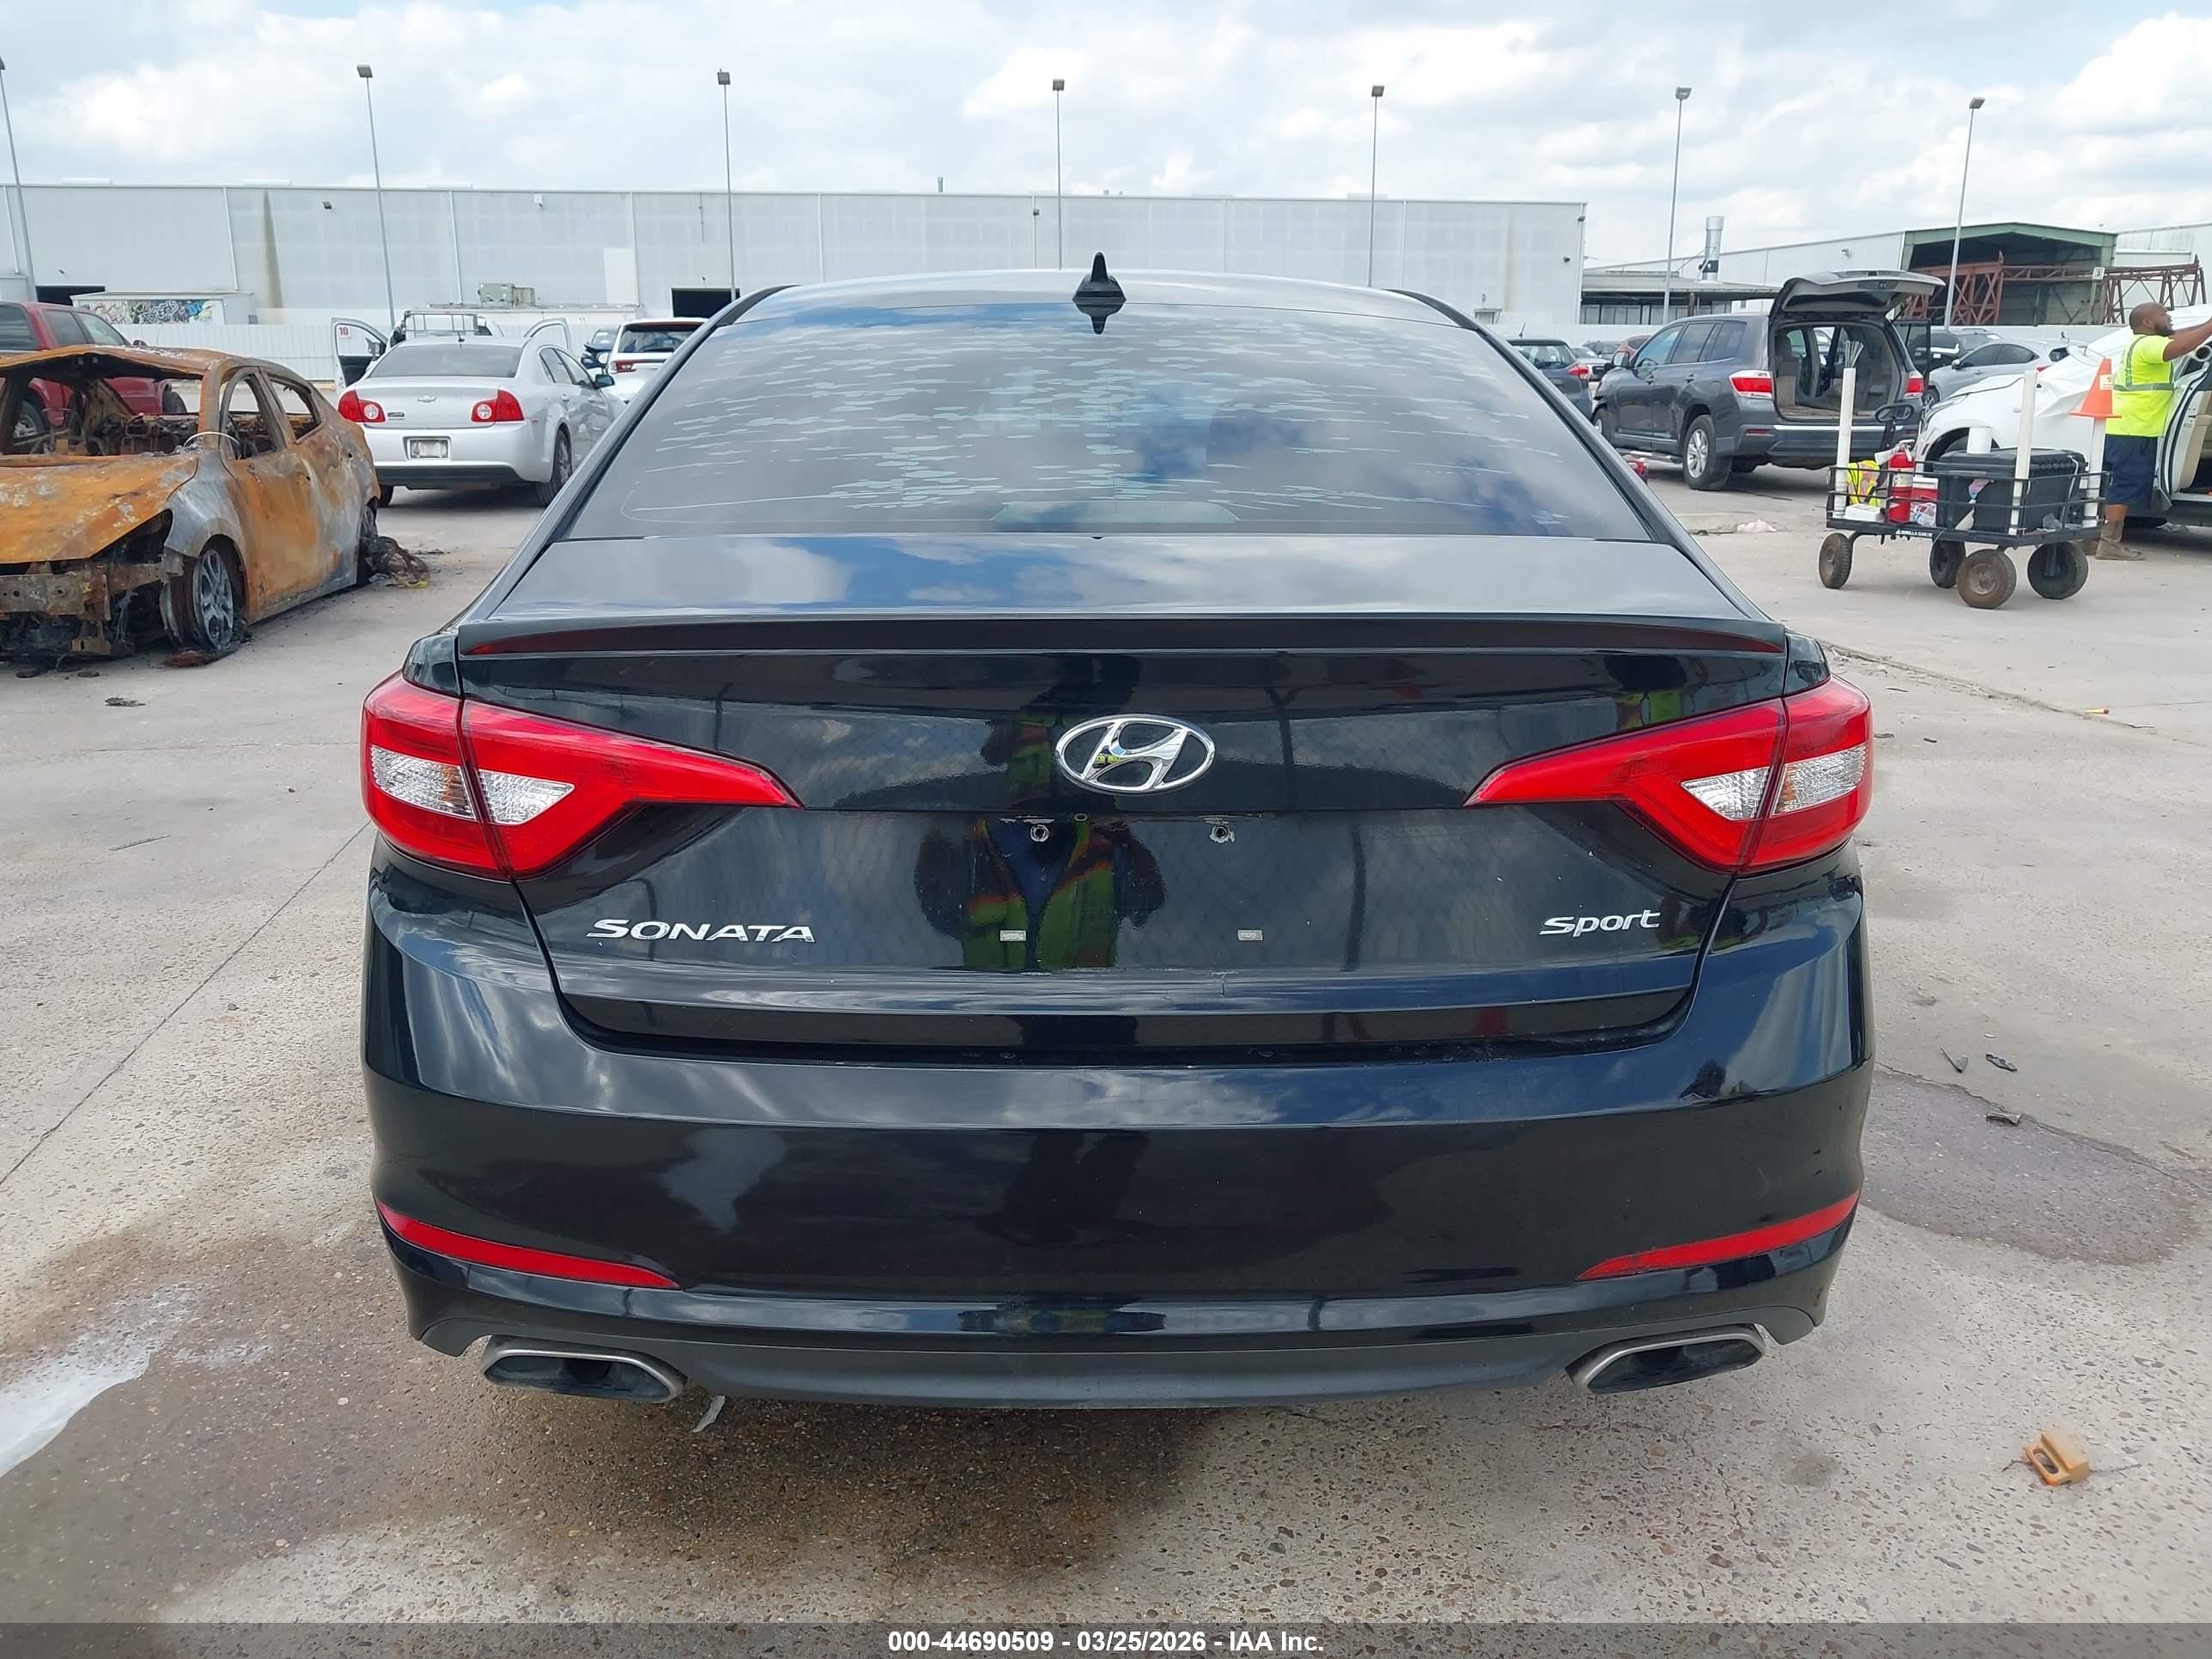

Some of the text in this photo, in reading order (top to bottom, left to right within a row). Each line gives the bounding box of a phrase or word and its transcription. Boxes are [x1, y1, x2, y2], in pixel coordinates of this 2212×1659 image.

[339, 326, 349, 336] 10
[586, 919, 817, 942] SONATA
[1539, 909, 1661, 938] Sport
